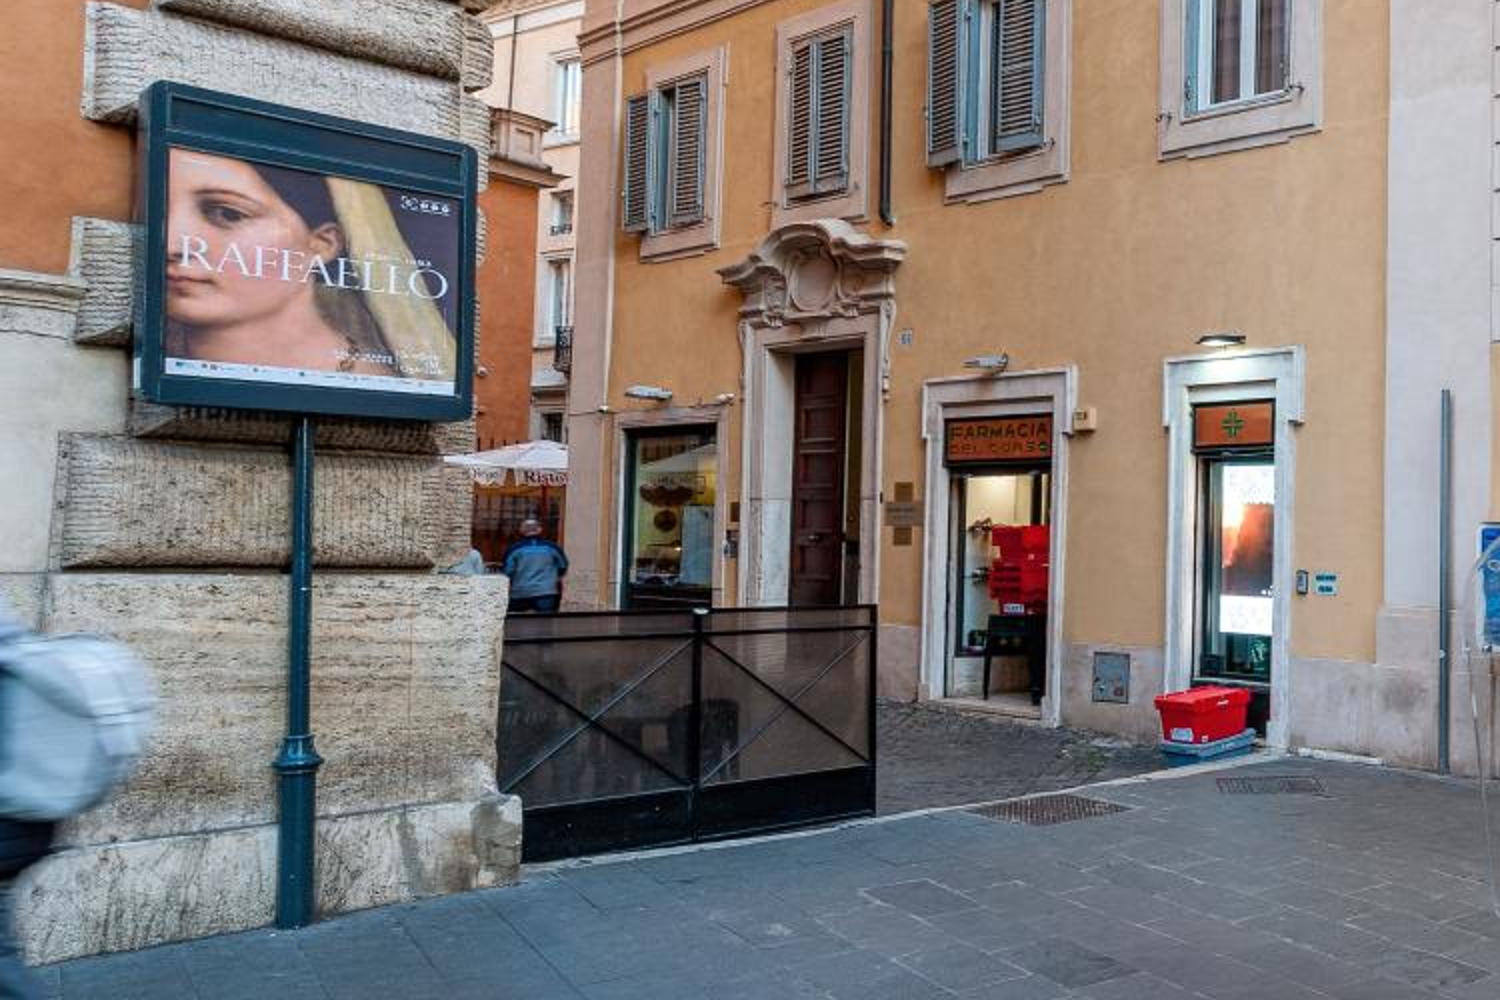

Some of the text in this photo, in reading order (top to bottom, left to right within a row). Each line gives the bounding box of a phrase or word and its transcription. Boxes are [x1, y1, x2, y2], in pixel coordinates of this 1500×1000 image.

[179, 233, 450, 301] RAFFAELLO
[950, 422, 1047, 441] FARMACIA
[989, 440, 1050, 454] CORSO
